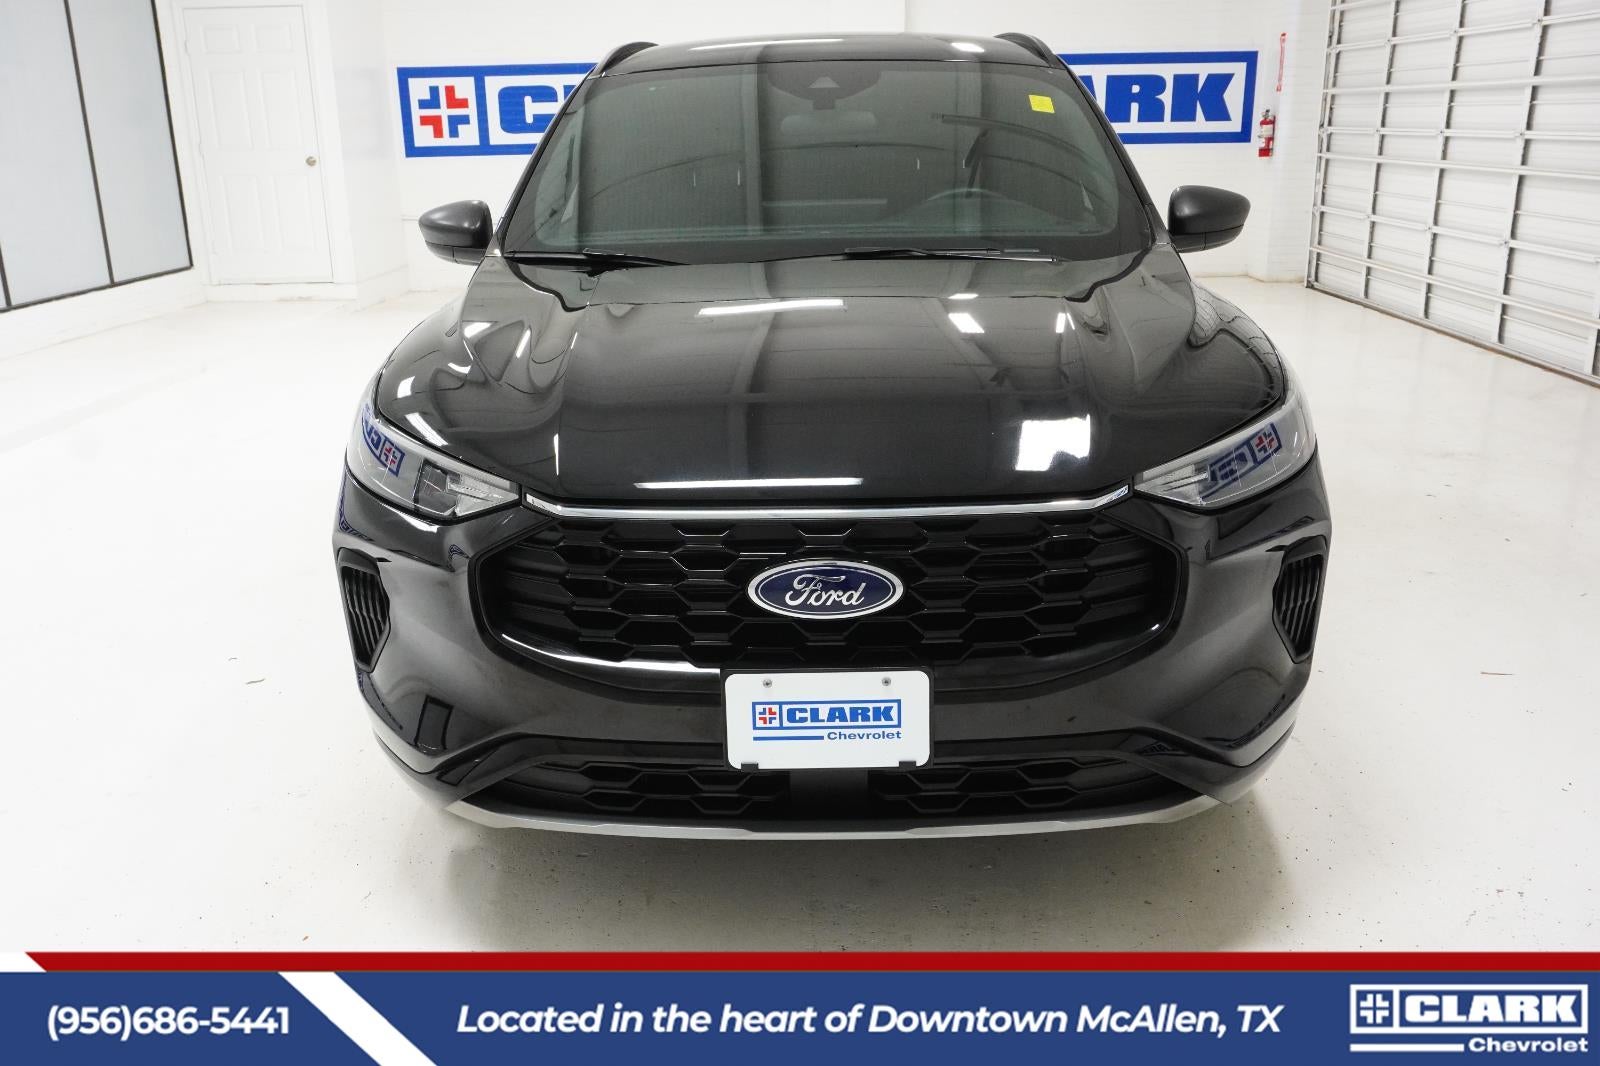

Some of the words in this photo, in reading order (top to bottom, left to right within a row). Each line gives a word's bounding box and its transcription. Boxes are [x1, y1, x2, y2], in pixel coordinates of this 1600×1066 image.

[785, 573, 867, 606] Ford
[786, 705, 894, 724] CLARK
[826, 730, 902, 741] Chevrolet
